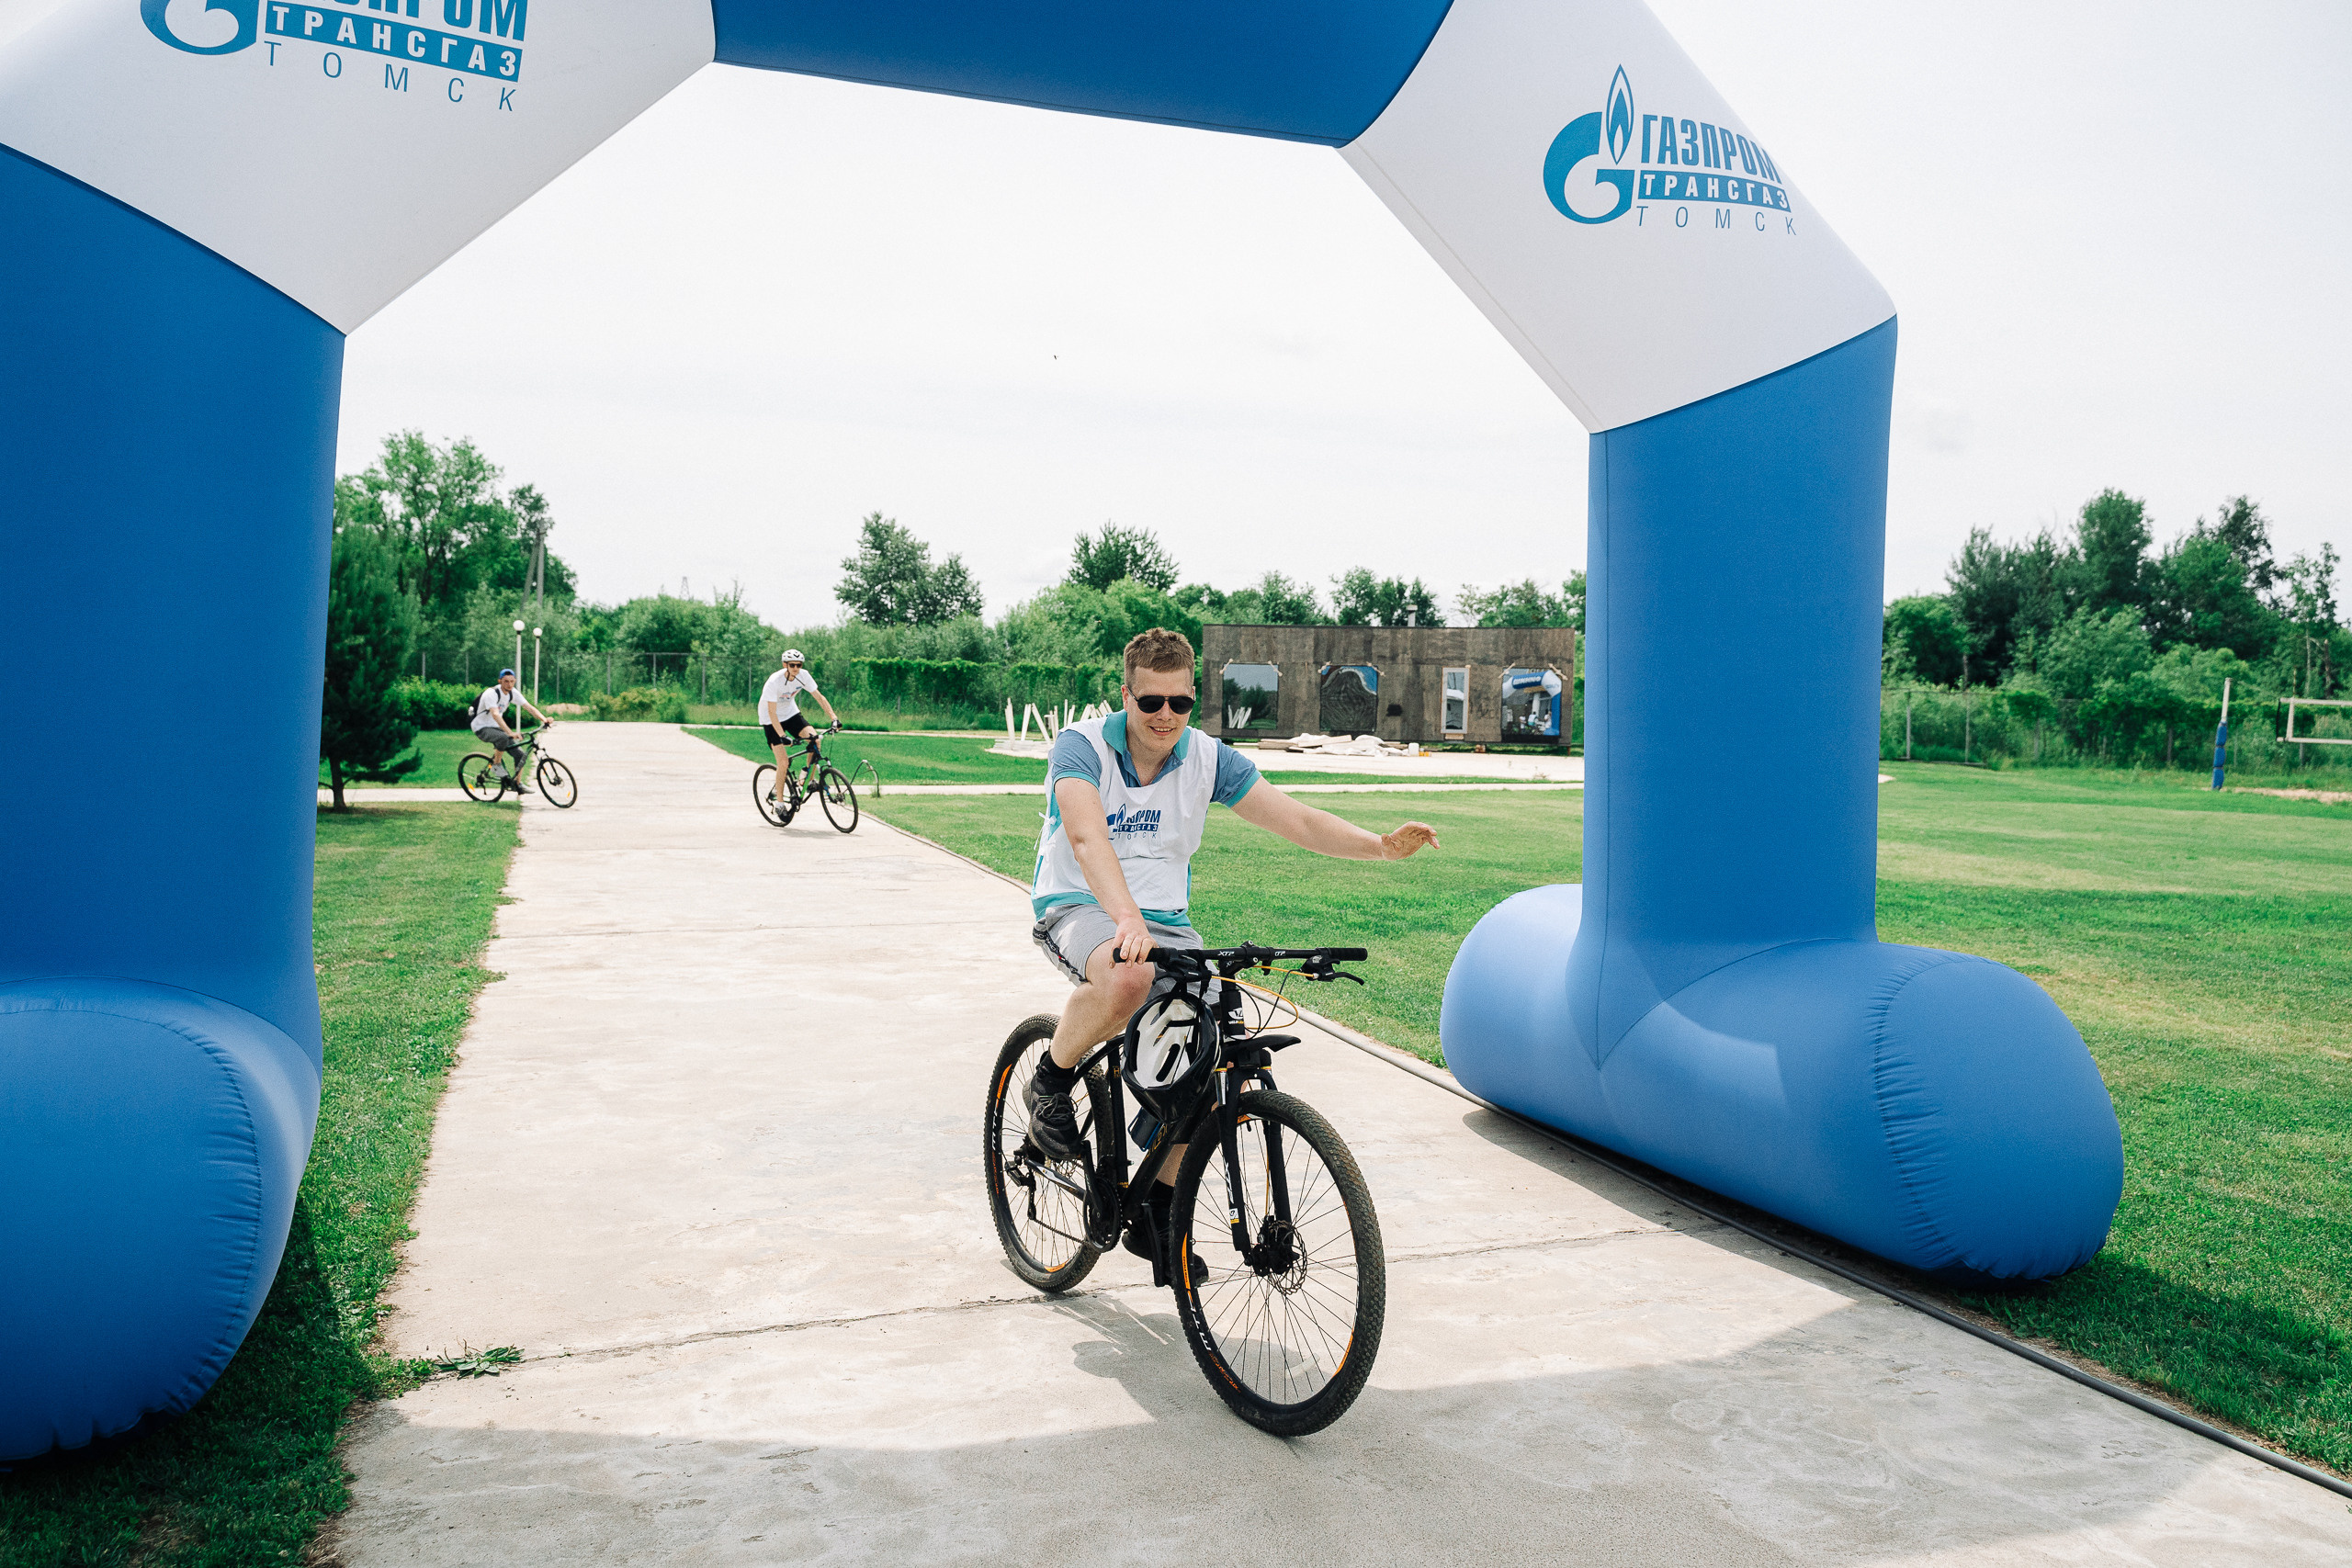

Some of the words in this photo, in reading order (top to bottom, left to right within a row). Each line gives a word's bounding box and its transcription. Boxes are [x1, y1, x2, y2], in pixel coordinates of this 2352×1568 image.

[264, 40, 517, 112] ТОМСК
[272, 5, 517, 77] ТРАНСГАЗ
[1641, 114, 1782, 185] ГАЗПРОМ
[1636, 206, 1797, 236] ТОМСК
[1643, 174, 1788, 209] ТРАНСГАЗ
